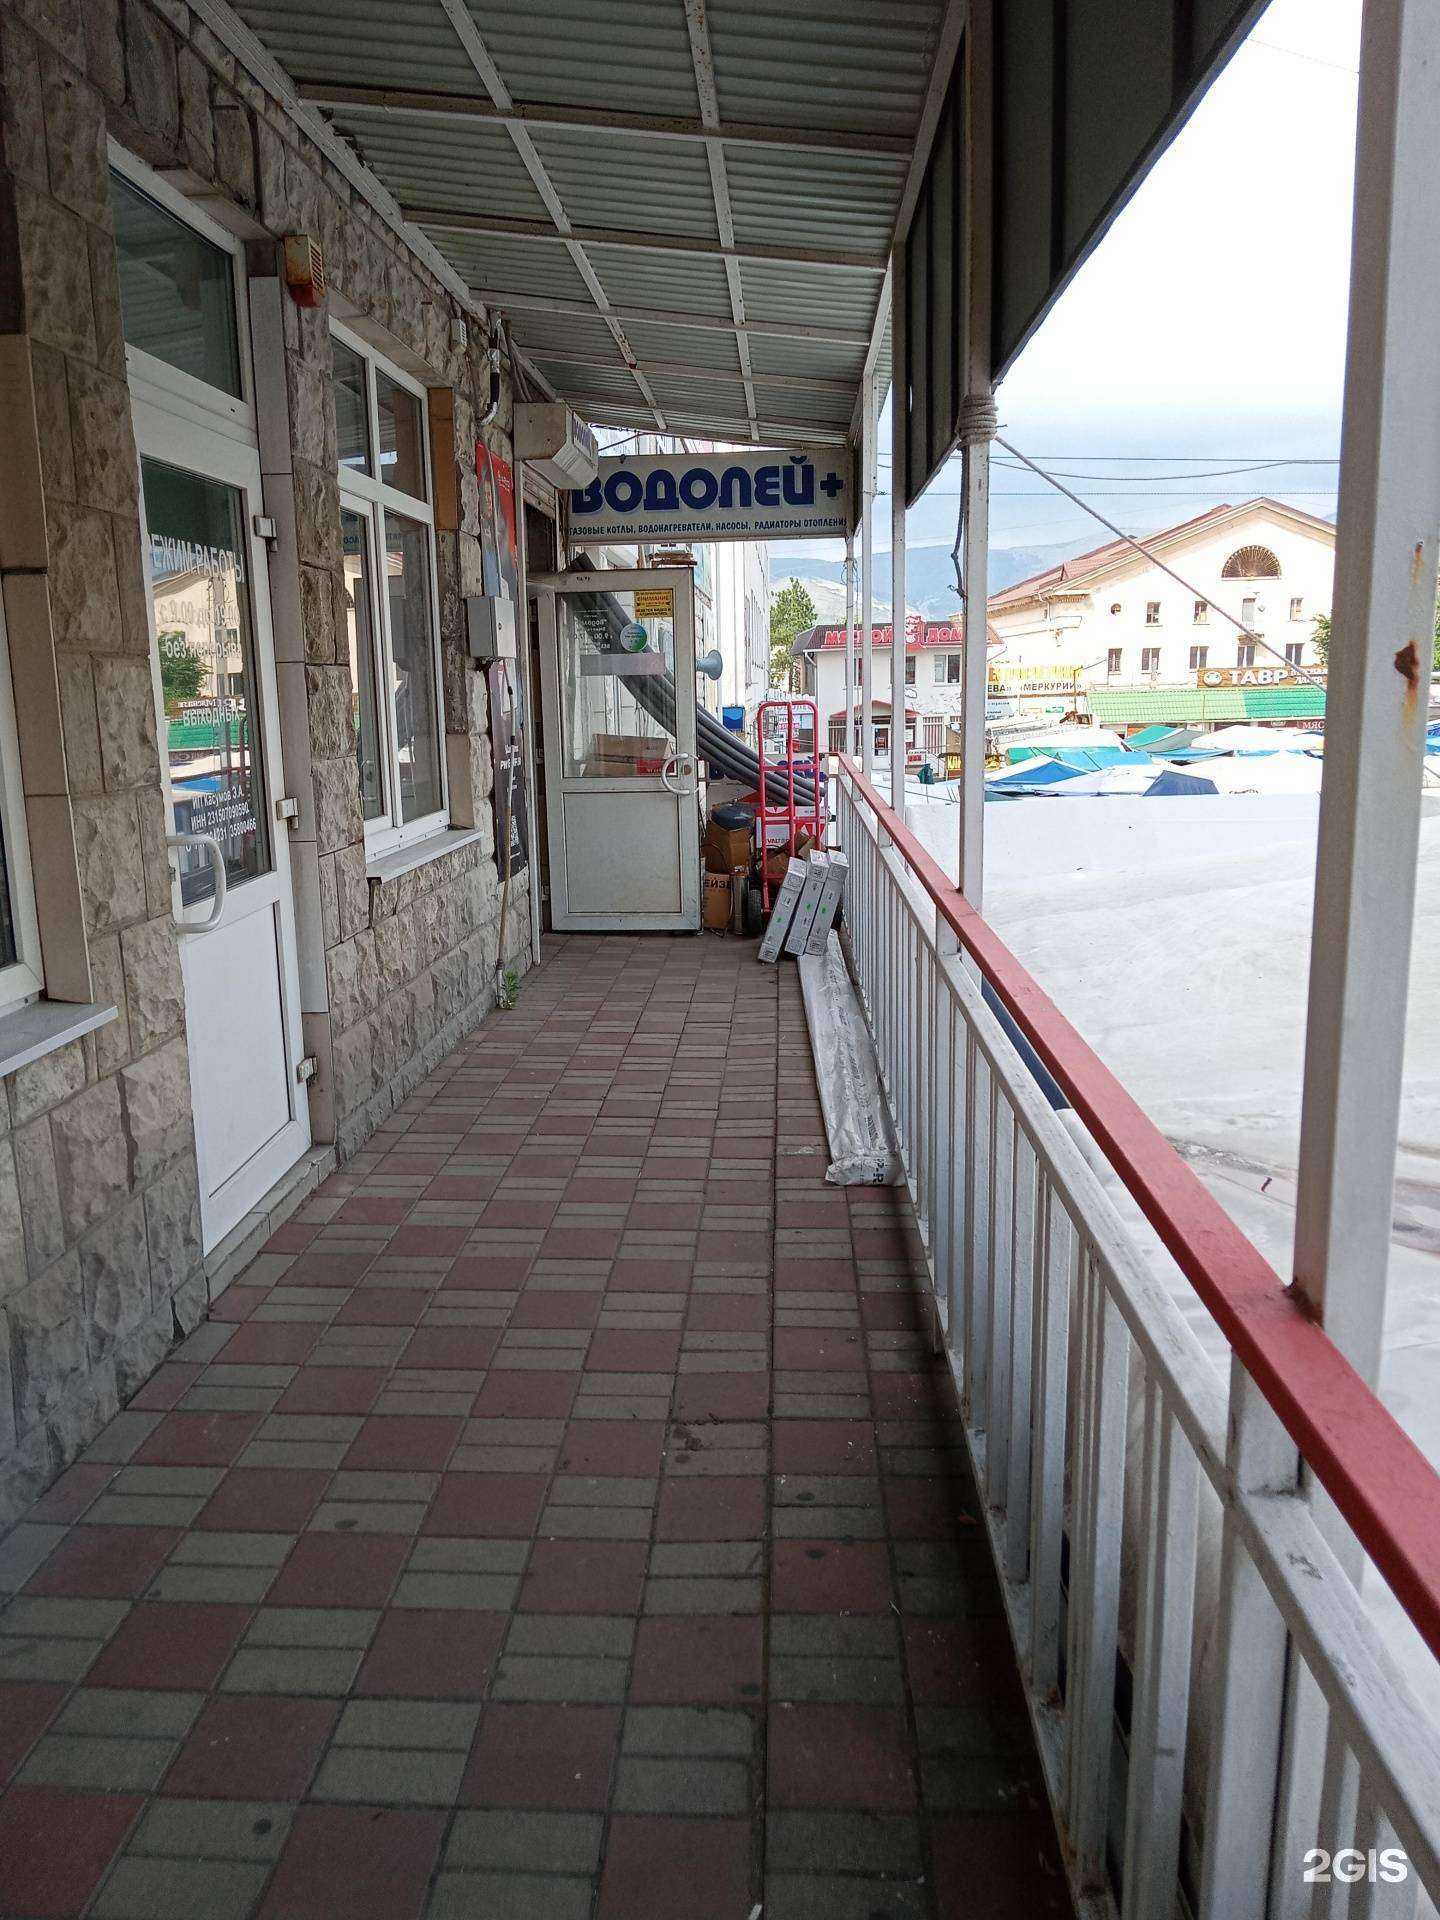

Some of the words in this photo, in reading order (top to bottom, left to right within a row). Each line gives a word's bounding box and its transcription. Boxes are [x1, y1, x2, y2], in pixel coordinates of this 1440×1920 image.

[754, 519, 801, 530] РАДИАТОРЫ
[151, 533, 193, 573] ЕЖИМ
[195, 543, 245, 583] РАБОТЫ
[190, 813, 206, 831] ИНН
